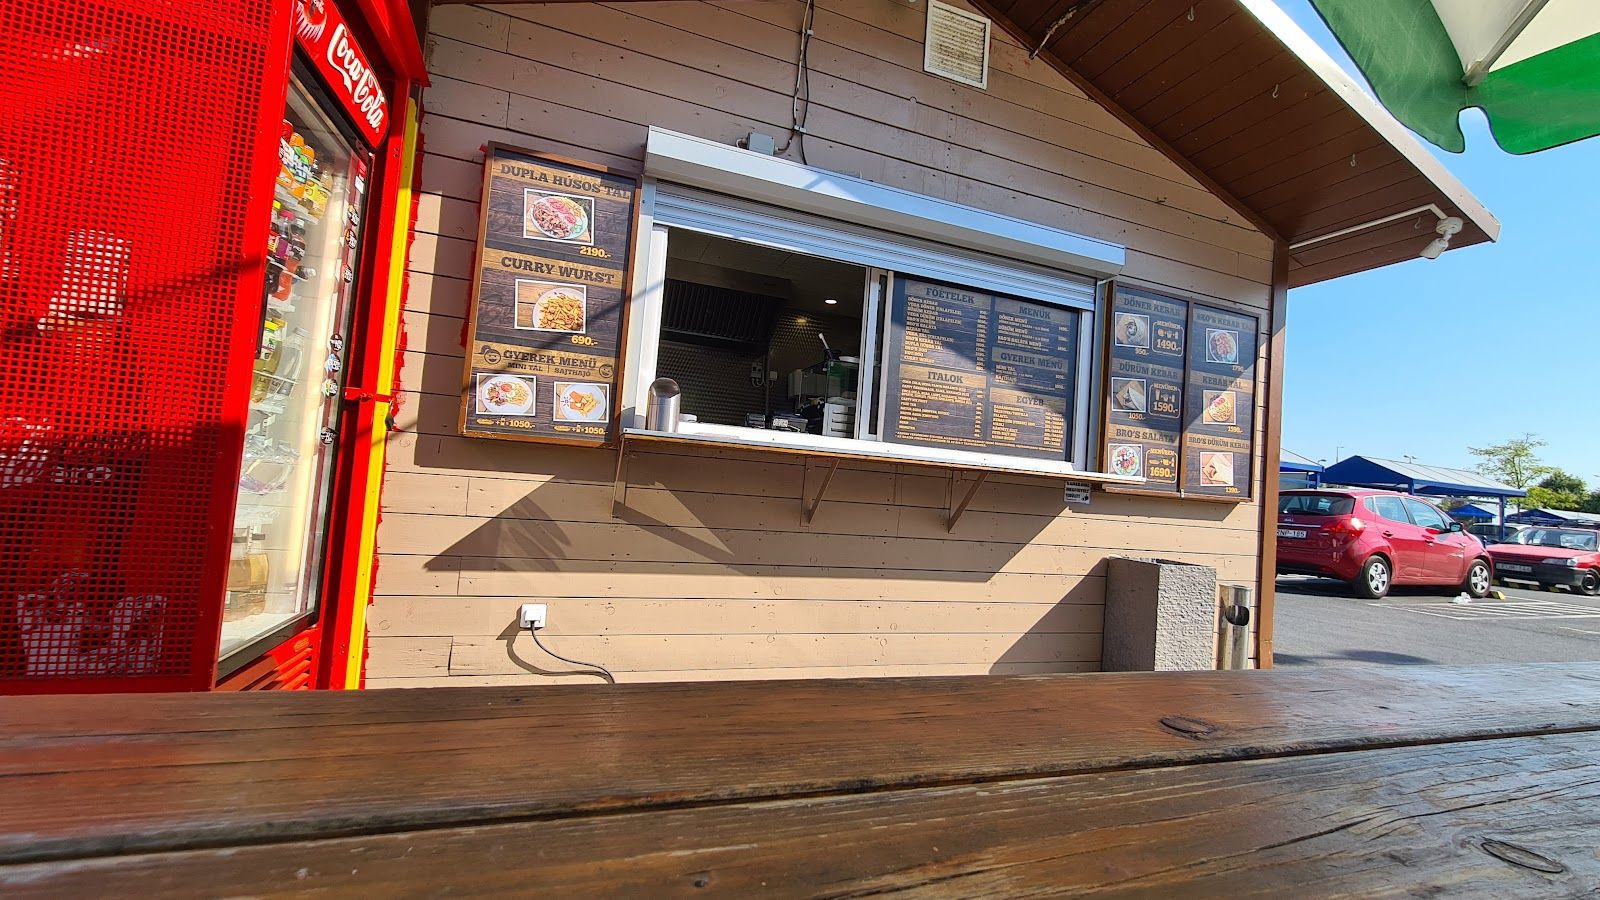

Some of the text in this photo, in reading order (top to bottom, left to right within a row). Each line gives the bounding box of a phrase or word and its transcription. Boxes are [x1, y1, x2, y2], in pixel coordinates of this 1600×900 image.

[500, 163, 548, 183] DUPLA
[552, 175, 601, 193] HÚSOS
[579, 245, 611, 258] 2190.-
[501, 256, 615, 284] CURRY WURST
[1124, 297, 1152, 311] DÖNER
[571, 334, 598, 346] 690.-
[1156, 338, 1182, 351] 1490.-
[503, 350, 597, 369] GYEREK MENÜ
[1000, 352, 1036, 365] GYEREK
[507, 362, 526, 370] MINI
[1119, 362, 1149, 375] DÜRÜM
[927, 370, 963, 384] ITALOK
[1153, 401, 1179, 413] 1590.-
[1115, 428, 1141, 439] BRO'S
[1149, 466, 1175, 478] 1690.-
